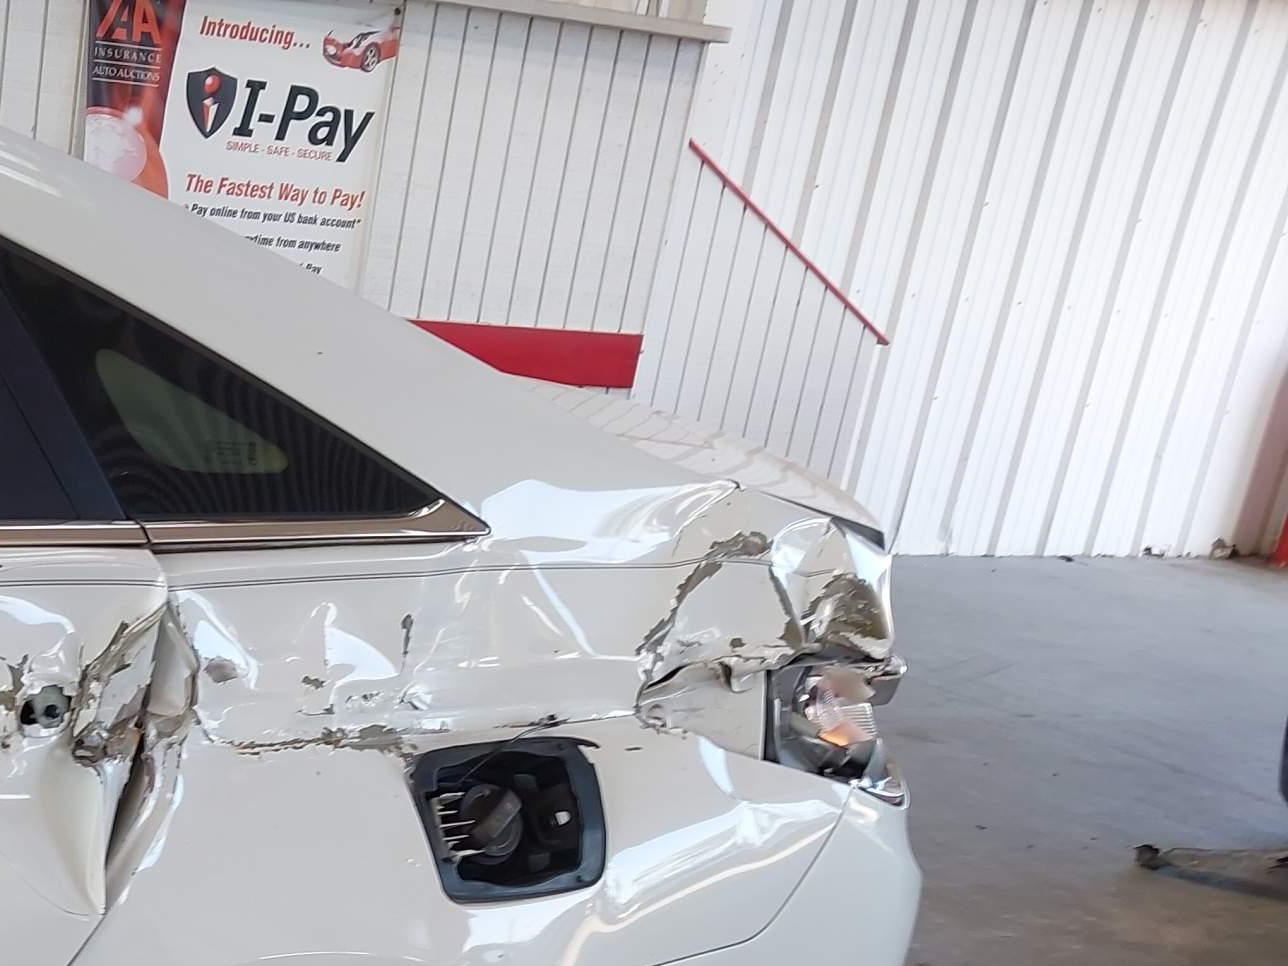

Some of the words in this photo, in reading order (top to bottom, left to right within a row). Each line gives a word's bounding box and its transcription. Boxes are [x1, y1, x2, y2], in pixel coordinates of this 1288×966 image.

[200, 16, 311, 50] Introducing...
[94, 47, 162, 64] INSURANCE
[92, 65, 117, 77] AUTO
[117, 69, 160, 82] AUCTIONS
[232, 79, 375, 163] I-Pay
[226, 141, 260, 154] SIMPLE
[267, 145, 290, 157] SAFE
[297, 148, 333, 161] SECURE
[185, 173, 213, 194] The
[217, 177, 274, 200] Fastest
[278, 183, 309, 206] Way
[313, 187, 327, 205] to
[330, 188, 367, 211] Pay!
[191, 203, 208, 217] Pay
[209, 206, 239, 218] online
[240, 209, 261, 221] from
[262, 212, 283, 224] your
[283, 213, 295, 224] US
[297, 215, 318, 226] bank
[275, 236, 297, 249] from
[298, 240, 341, 254] anywhere
